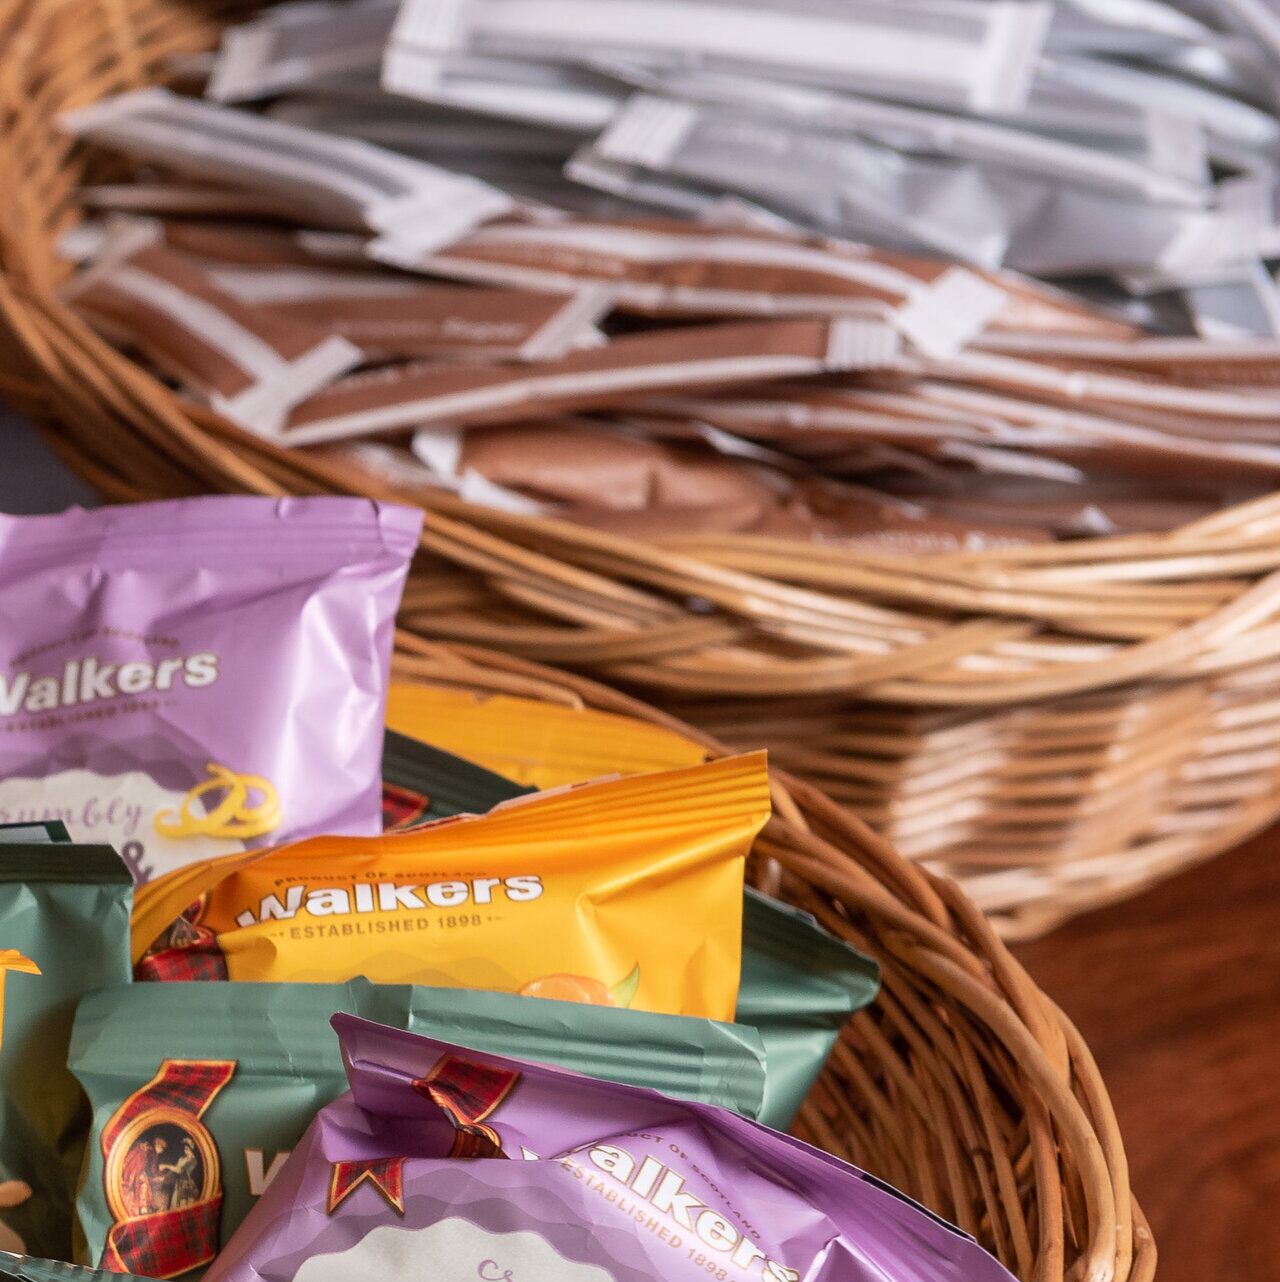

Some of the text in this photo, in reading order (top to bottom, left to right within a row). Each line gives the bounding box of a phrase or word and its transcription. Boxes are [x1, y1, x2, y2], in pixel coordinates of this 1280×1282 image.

[236, 874, 545, 929] Walkers
[289, 913, 483, 940] ESTABLISHED 1898
[560, 1155, 729, 1282] ESTABLISHED 1898
[691, 1163, 762, 1241] SCOTLAND
